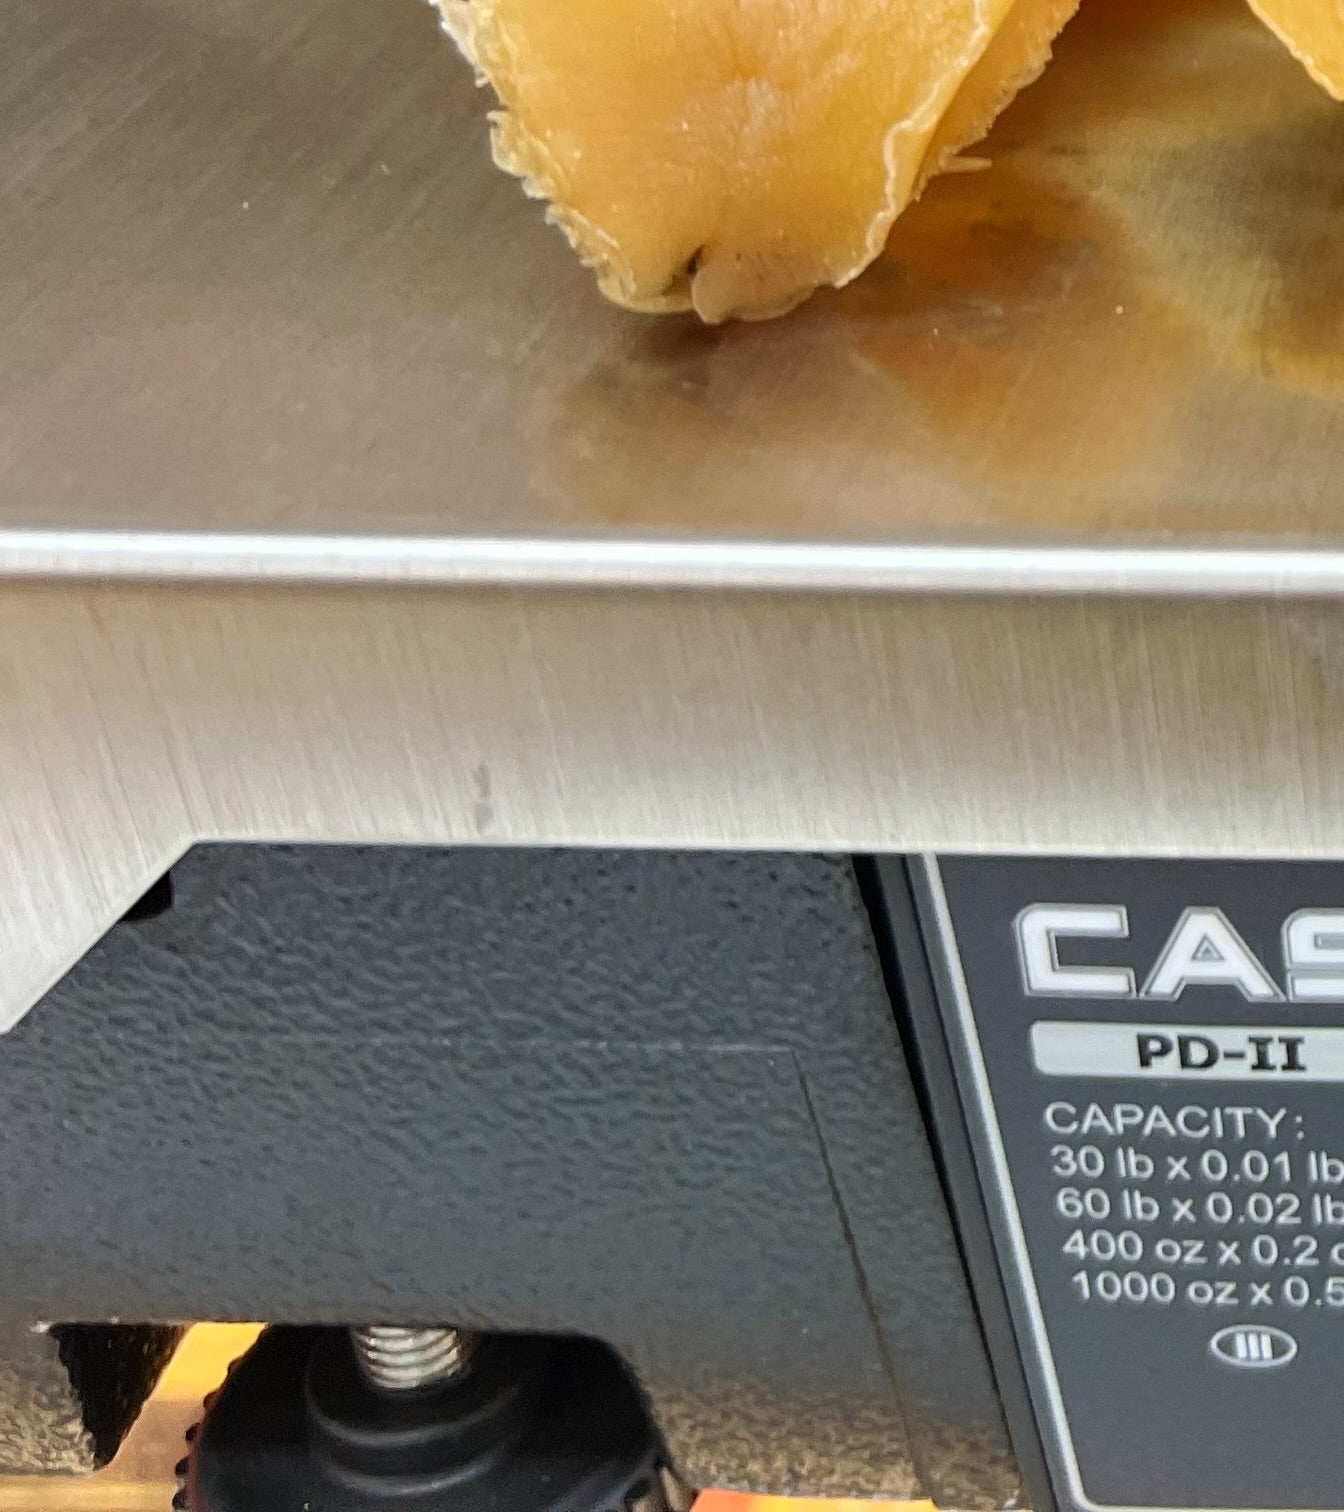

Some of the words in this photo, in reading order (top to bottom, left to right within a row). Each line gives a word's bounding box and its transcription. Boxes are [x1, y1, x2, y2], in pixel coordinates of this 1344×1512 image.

[1136, 1033, 1306, 1072] PD-II
[1050, 1144, 1105, 1178] 30
[1117, 1146, 1154, 1180] lb
[1167, 1155, 1192, 1182] x
[1200, 1149, 1291, 1184] 0.01
[1056, 1187, 1111, 1220] 60
[1122, 1189, 1160, 1222] lb
[1171, 1197, 1197, 1224] x
[1205, 1192, 1302, 1226] 0.02
[1062, 1229, 1144, 1262] 400
[1154, 1238, 1208, 1265] oz
[1218, 1240, 1241, 1267] x
[1251, 1233, 1320, 1267] 0.2
[1071, 1269, 1176, 1304] 1000
[1186, 1280, 1240, 1306] oz
[1249, 1282, 1273, 1307] x
